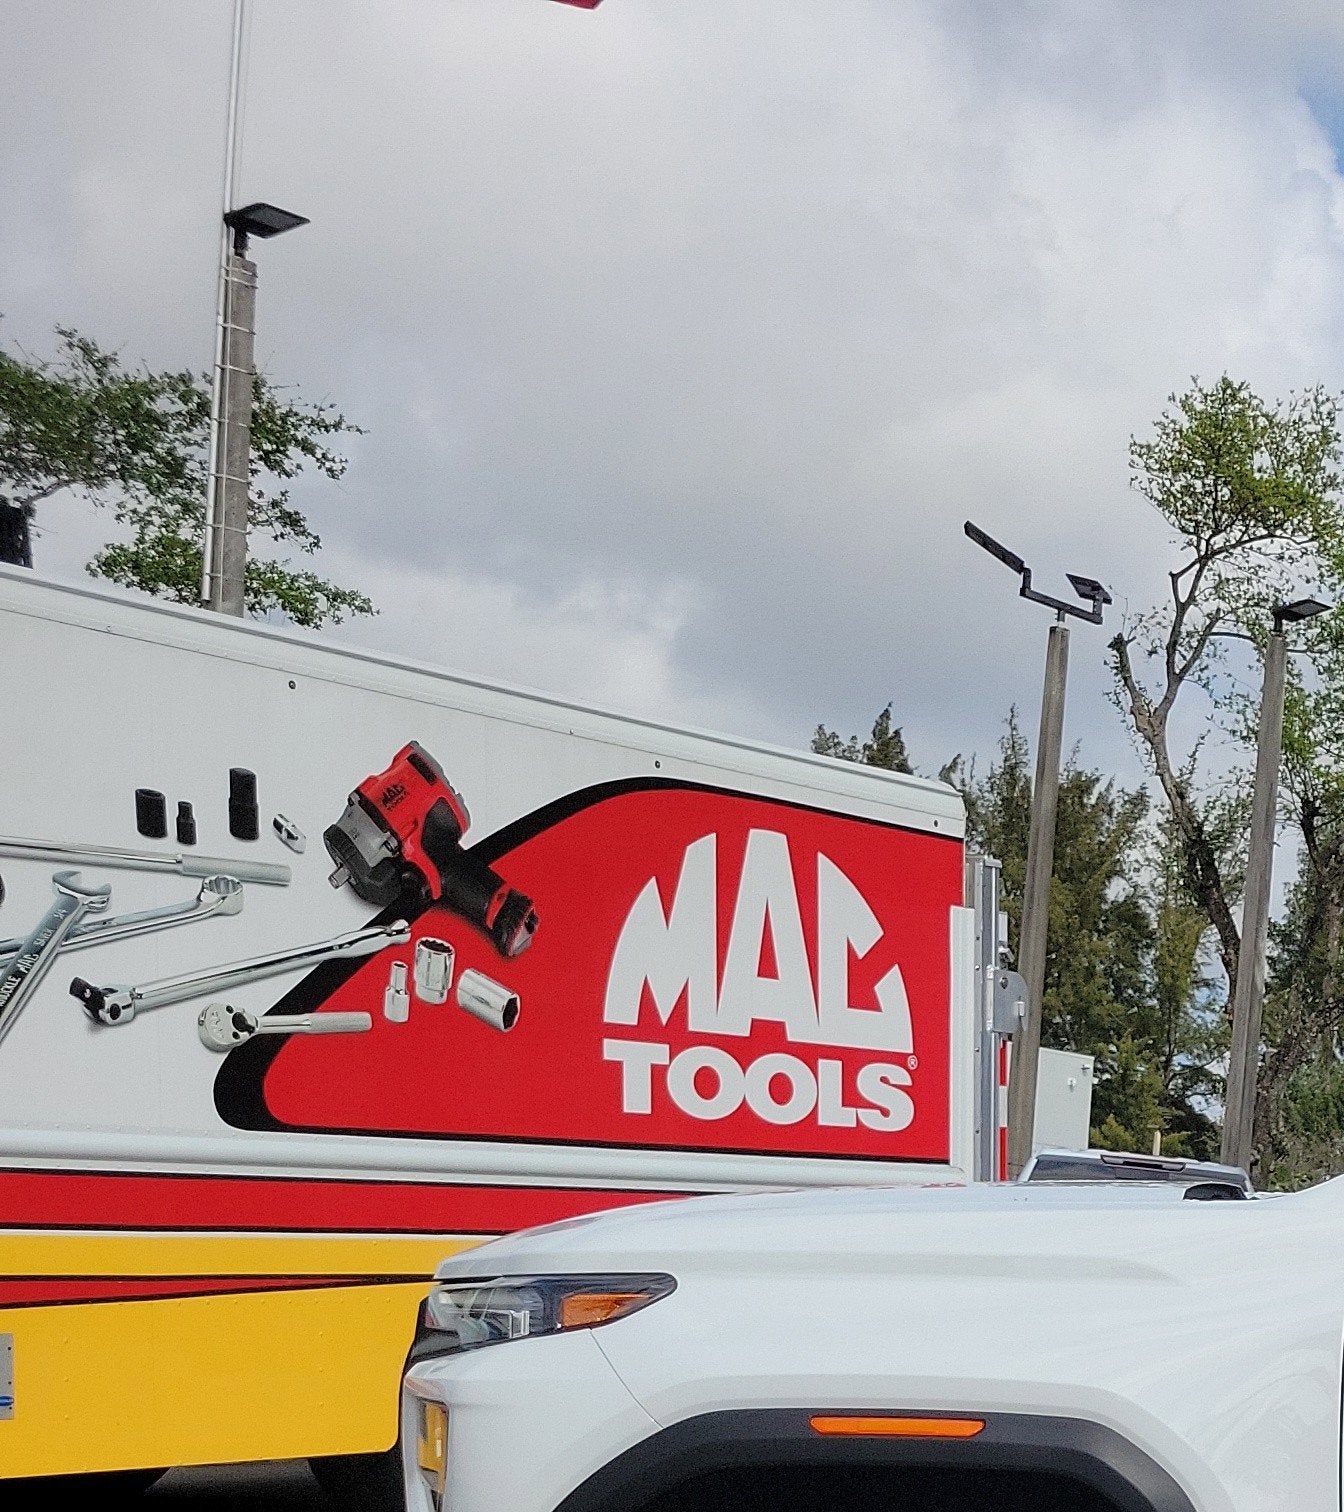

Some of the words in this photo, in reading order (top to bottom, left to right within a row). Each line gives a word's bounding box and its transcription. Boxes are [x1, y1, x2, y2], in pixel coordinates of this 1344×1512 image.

[16, 954, 39, 974] MAC
[603, 828, 914, 1053] MAC
[603, 1038, 915, 1131] TOOLS
